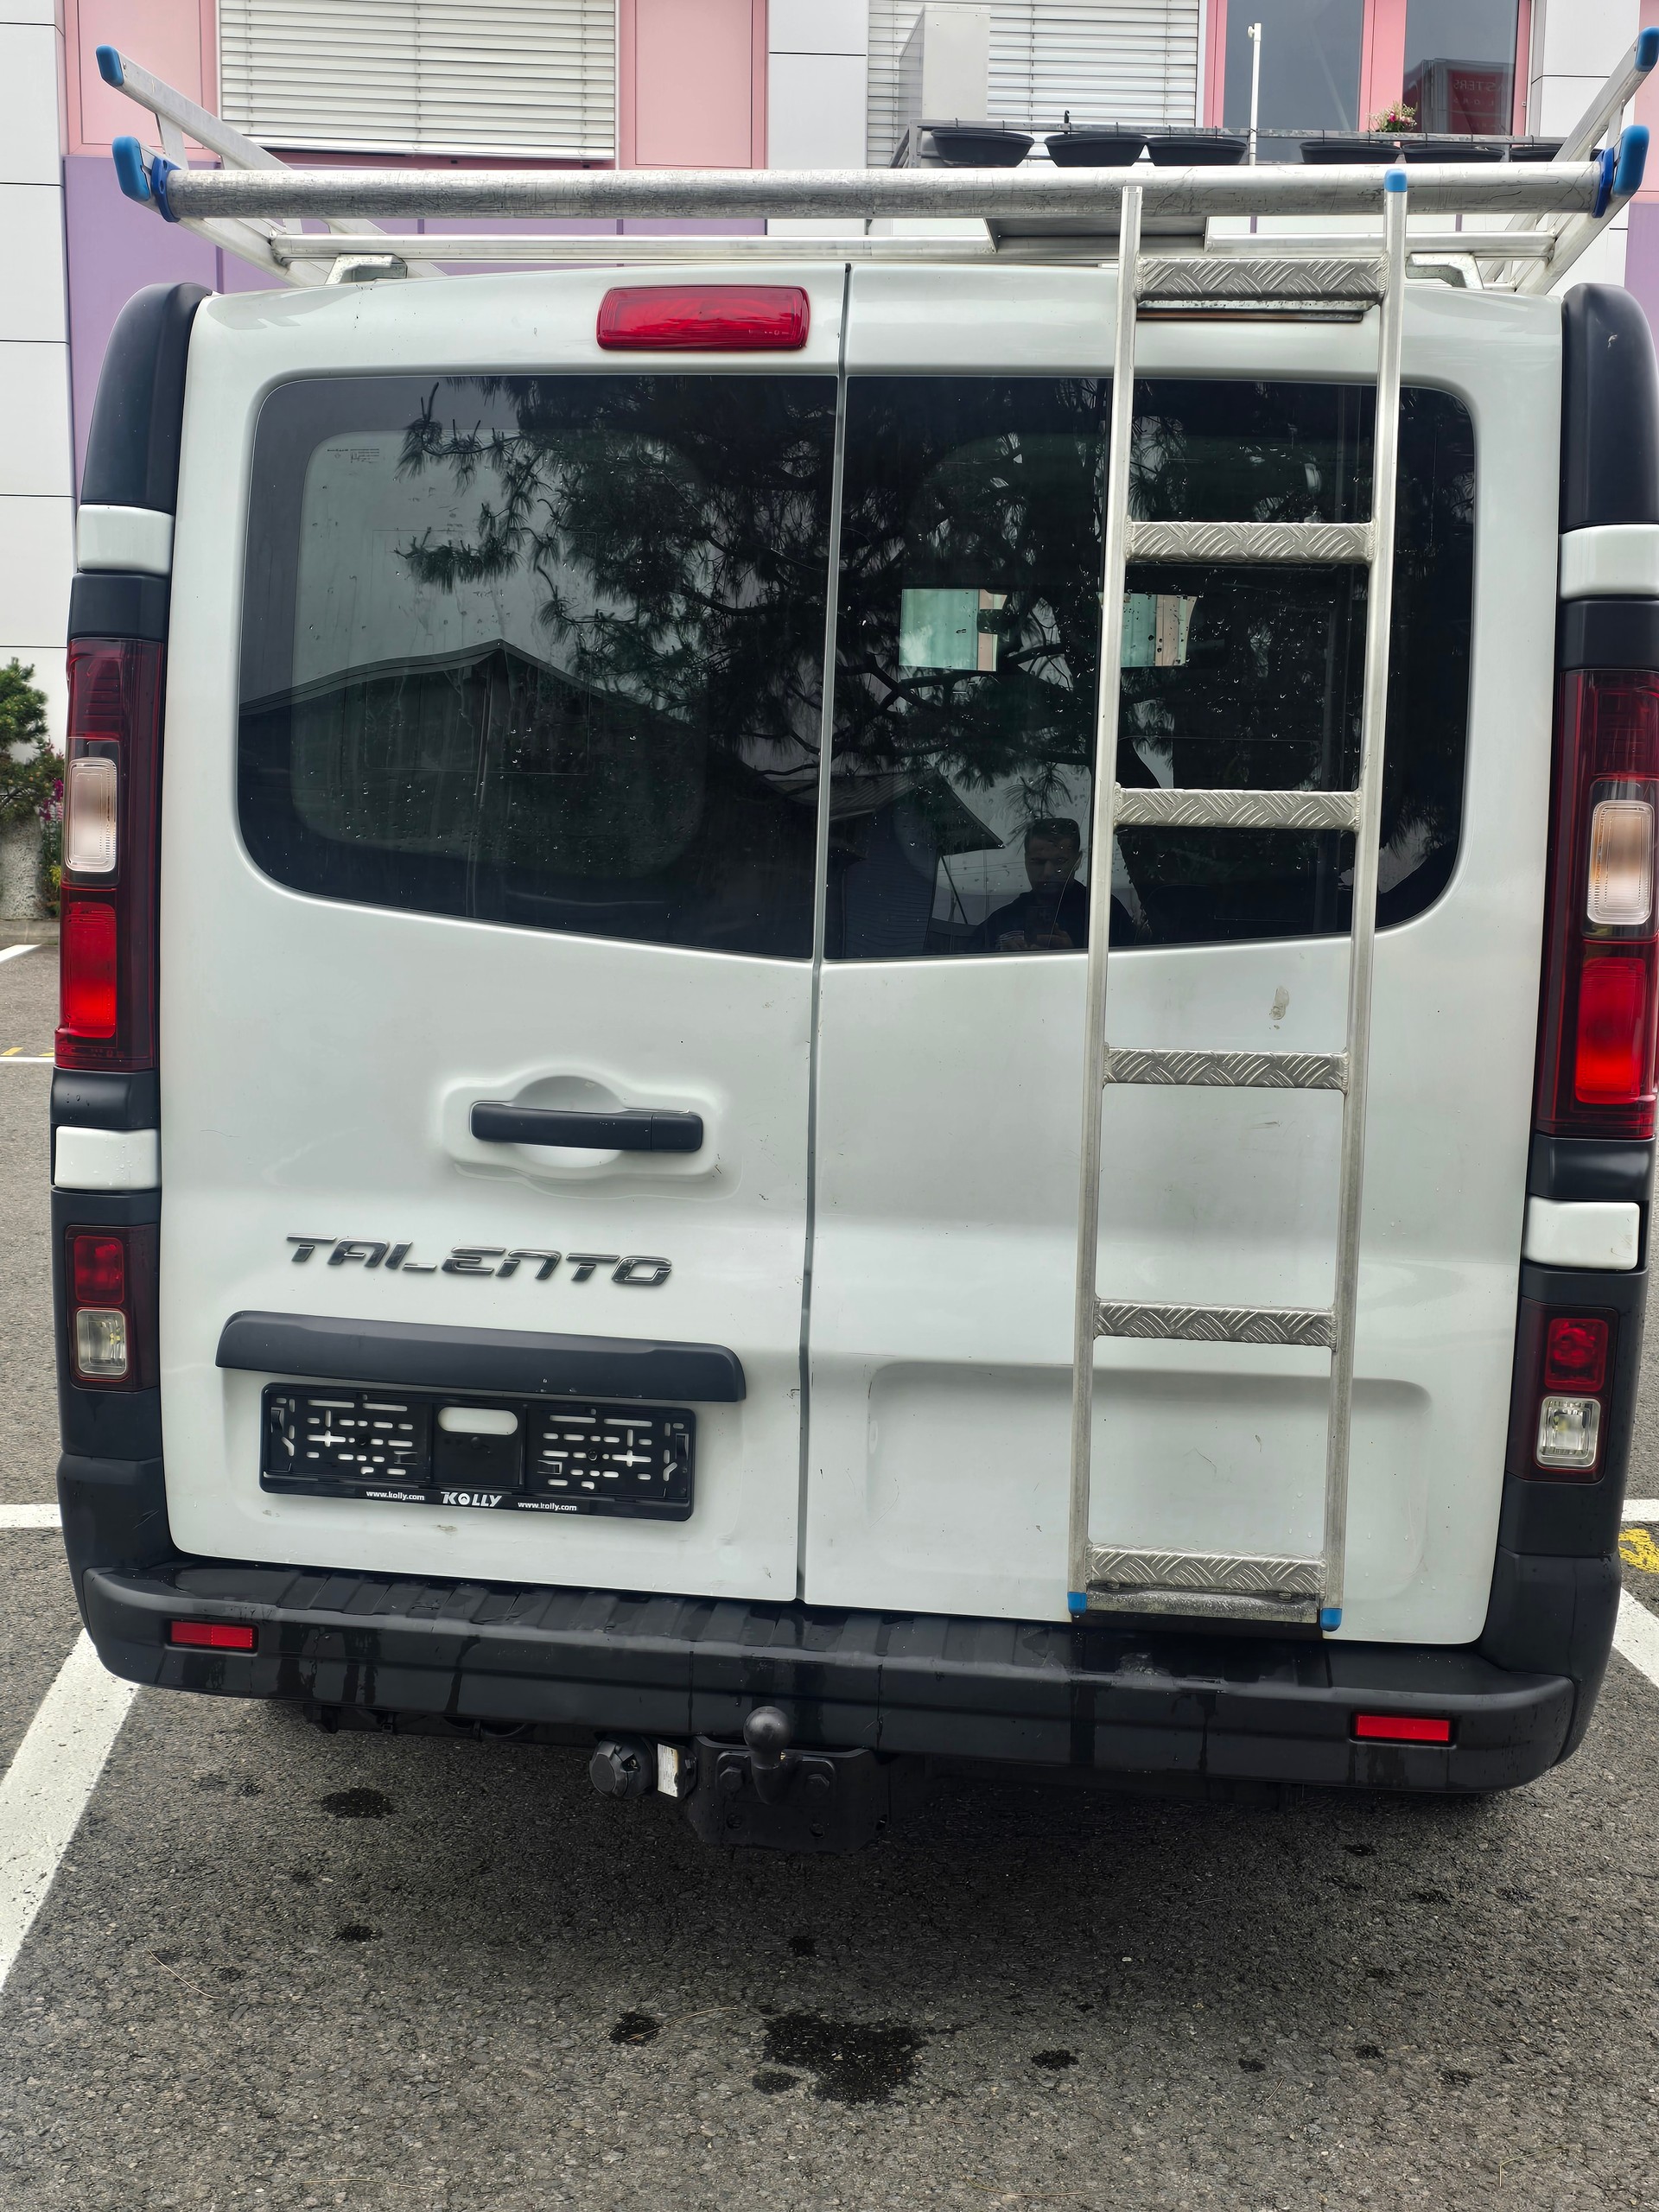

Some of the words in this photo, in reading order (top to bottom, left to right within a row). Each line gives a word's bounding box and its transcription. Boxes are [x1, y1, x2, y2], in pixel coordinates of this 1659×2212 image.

[286, 1232, 672, 1287] TALENTO
[365, 1491, 425, 1502] www.kolly.com
[441, 1491, 502, 1508] KOLLY
